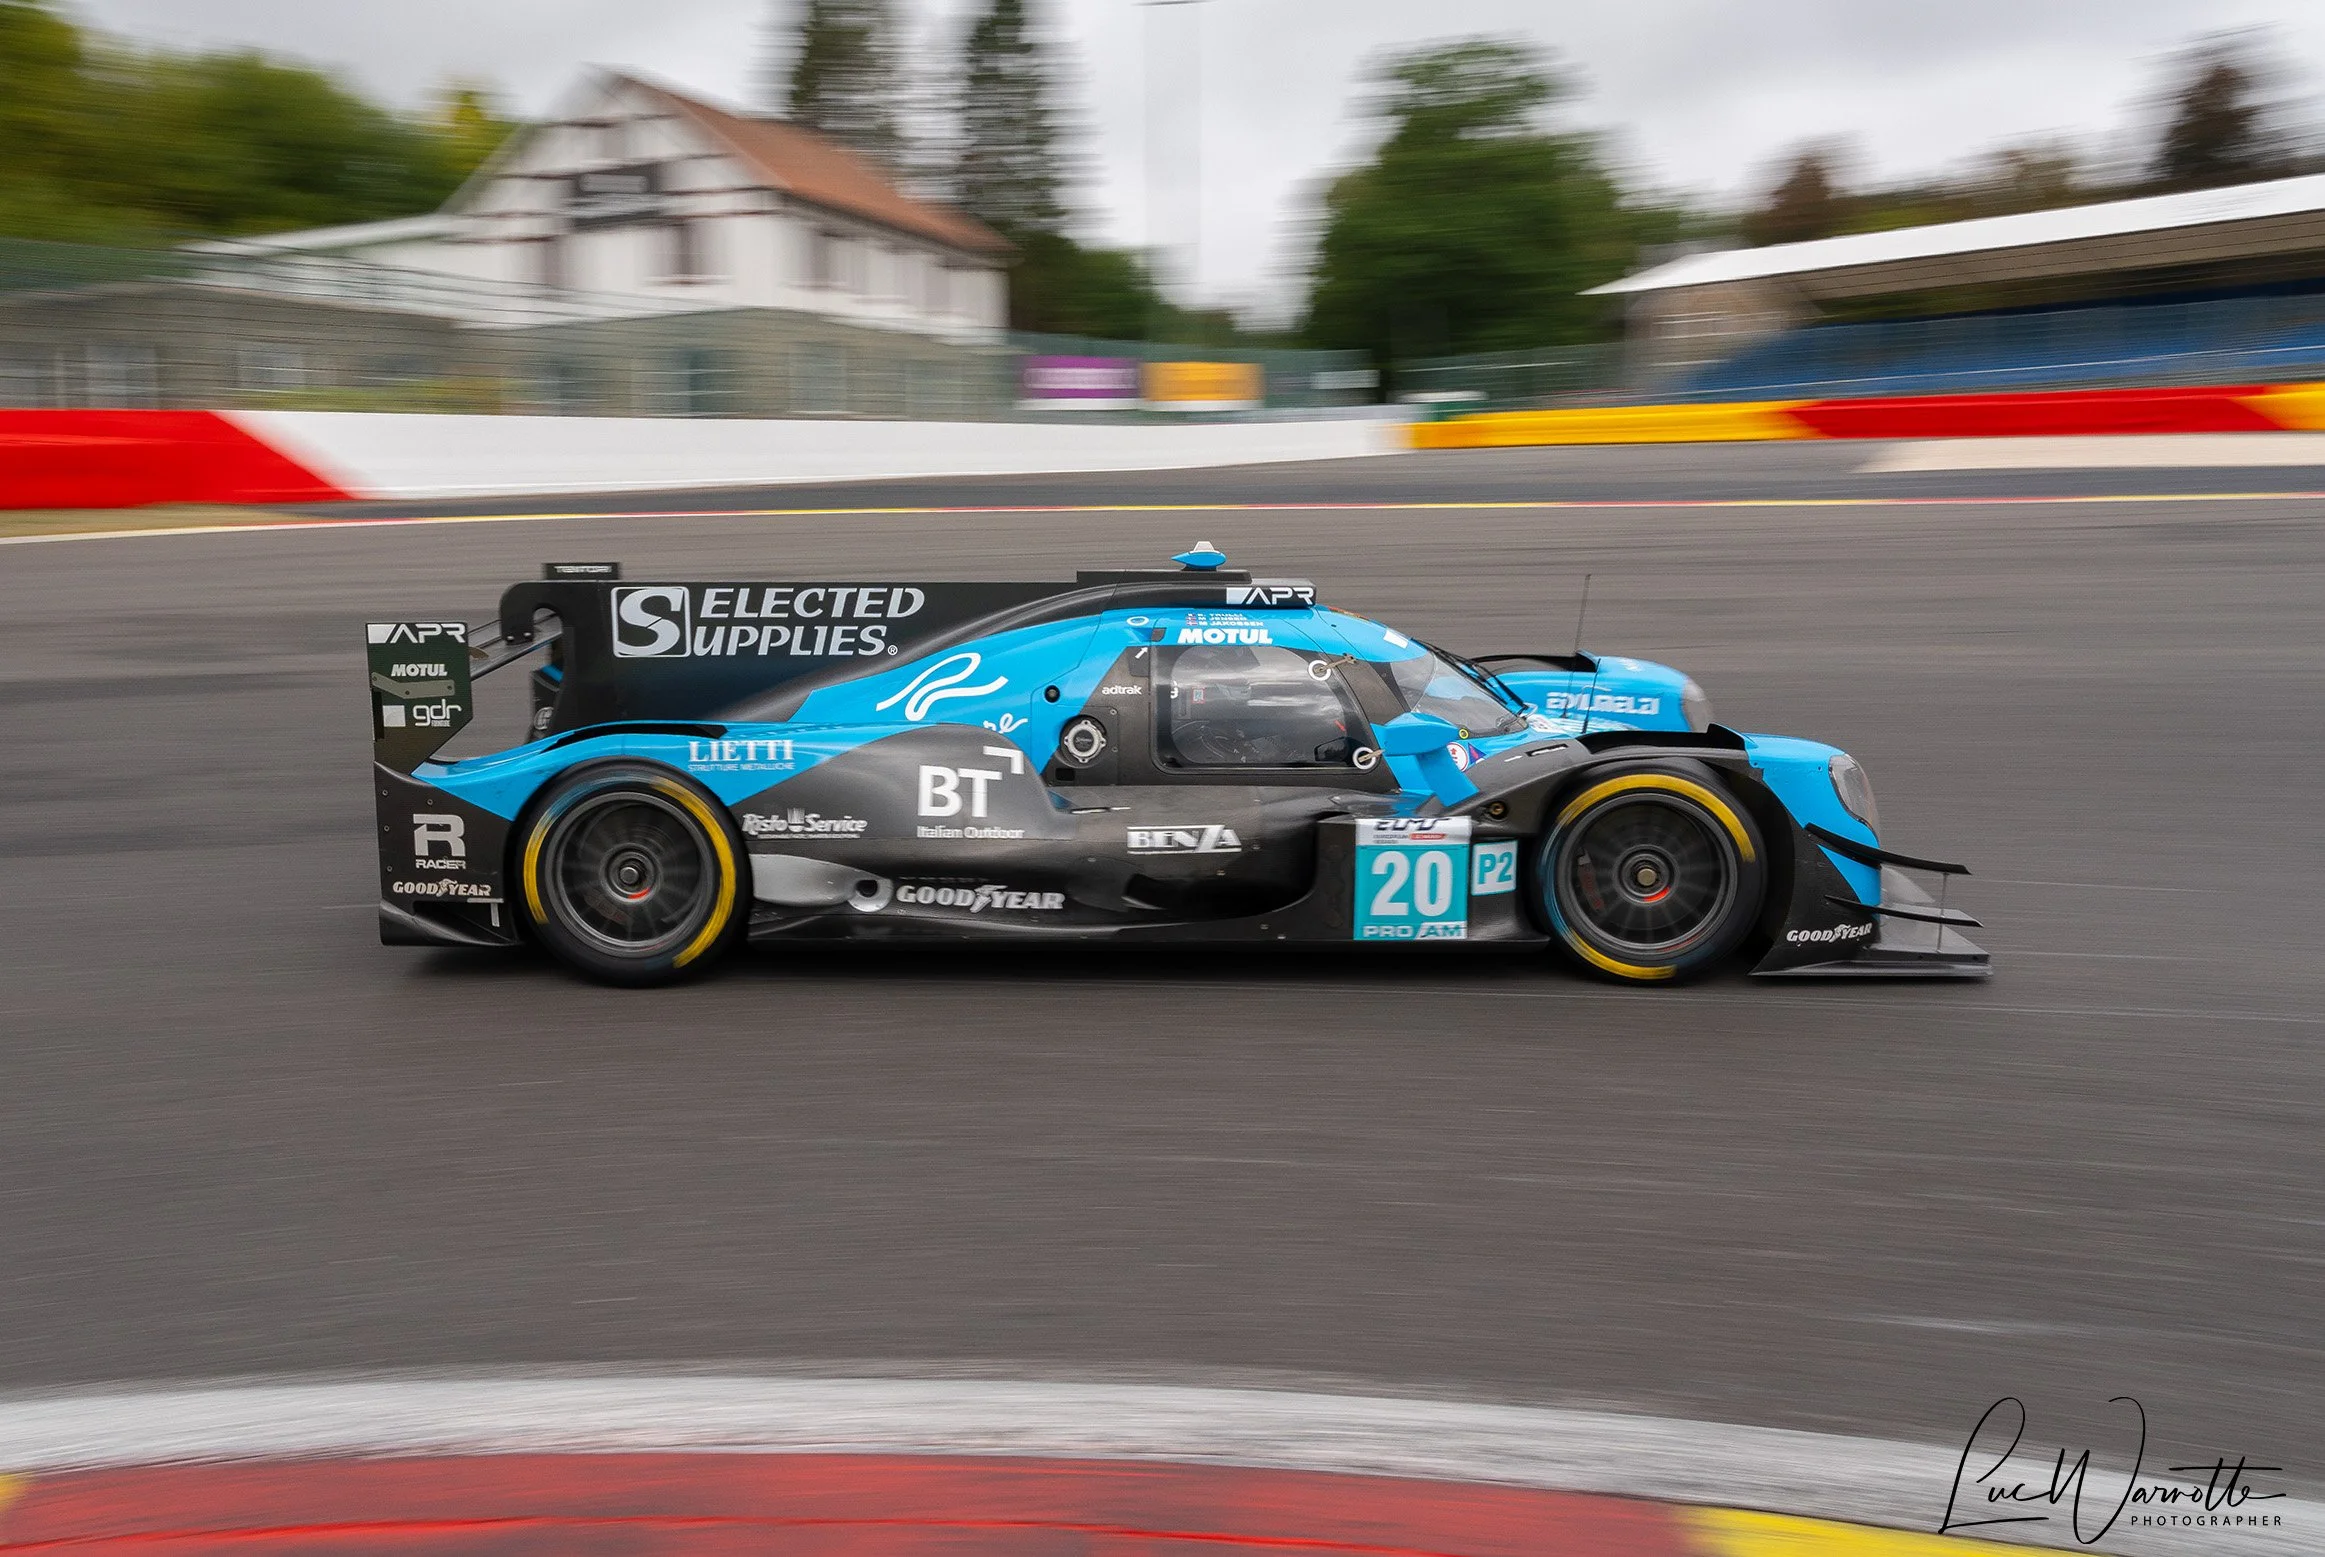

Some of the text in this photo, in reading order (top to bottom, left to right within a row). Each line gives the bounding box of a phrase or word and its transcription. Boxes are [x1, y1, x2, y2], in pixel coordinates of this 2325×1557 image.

[1245, 587, 1314, 605] APR
[390, 623, 465, 644] APR
[1177, 628, 1274, 645] MOTUL
[390, 663, 448, 677] MOTUL
[1101, 685, 1142, 695] adtrak
[413, 699, 462, 727] gdr
[688, 740, 795, 762] LIETTI
[917, 764, 1002, 818] BT
[804, 813, 868, 832] Service
[917, 826, 1025, 839] Italian Outdoor
[415, 859, 467, 870] RACER
[1477, 851, 1514, 885] P2
[392, 878, 492, 897] GOODYEAR
[1370, 851, 1453, 917] 20
[896, 884, 1066, 913] GOODYEAR
[1362, 924, 1466, 938] PRO AM
[1786, 922, 1873, 943] GOODYEAR
